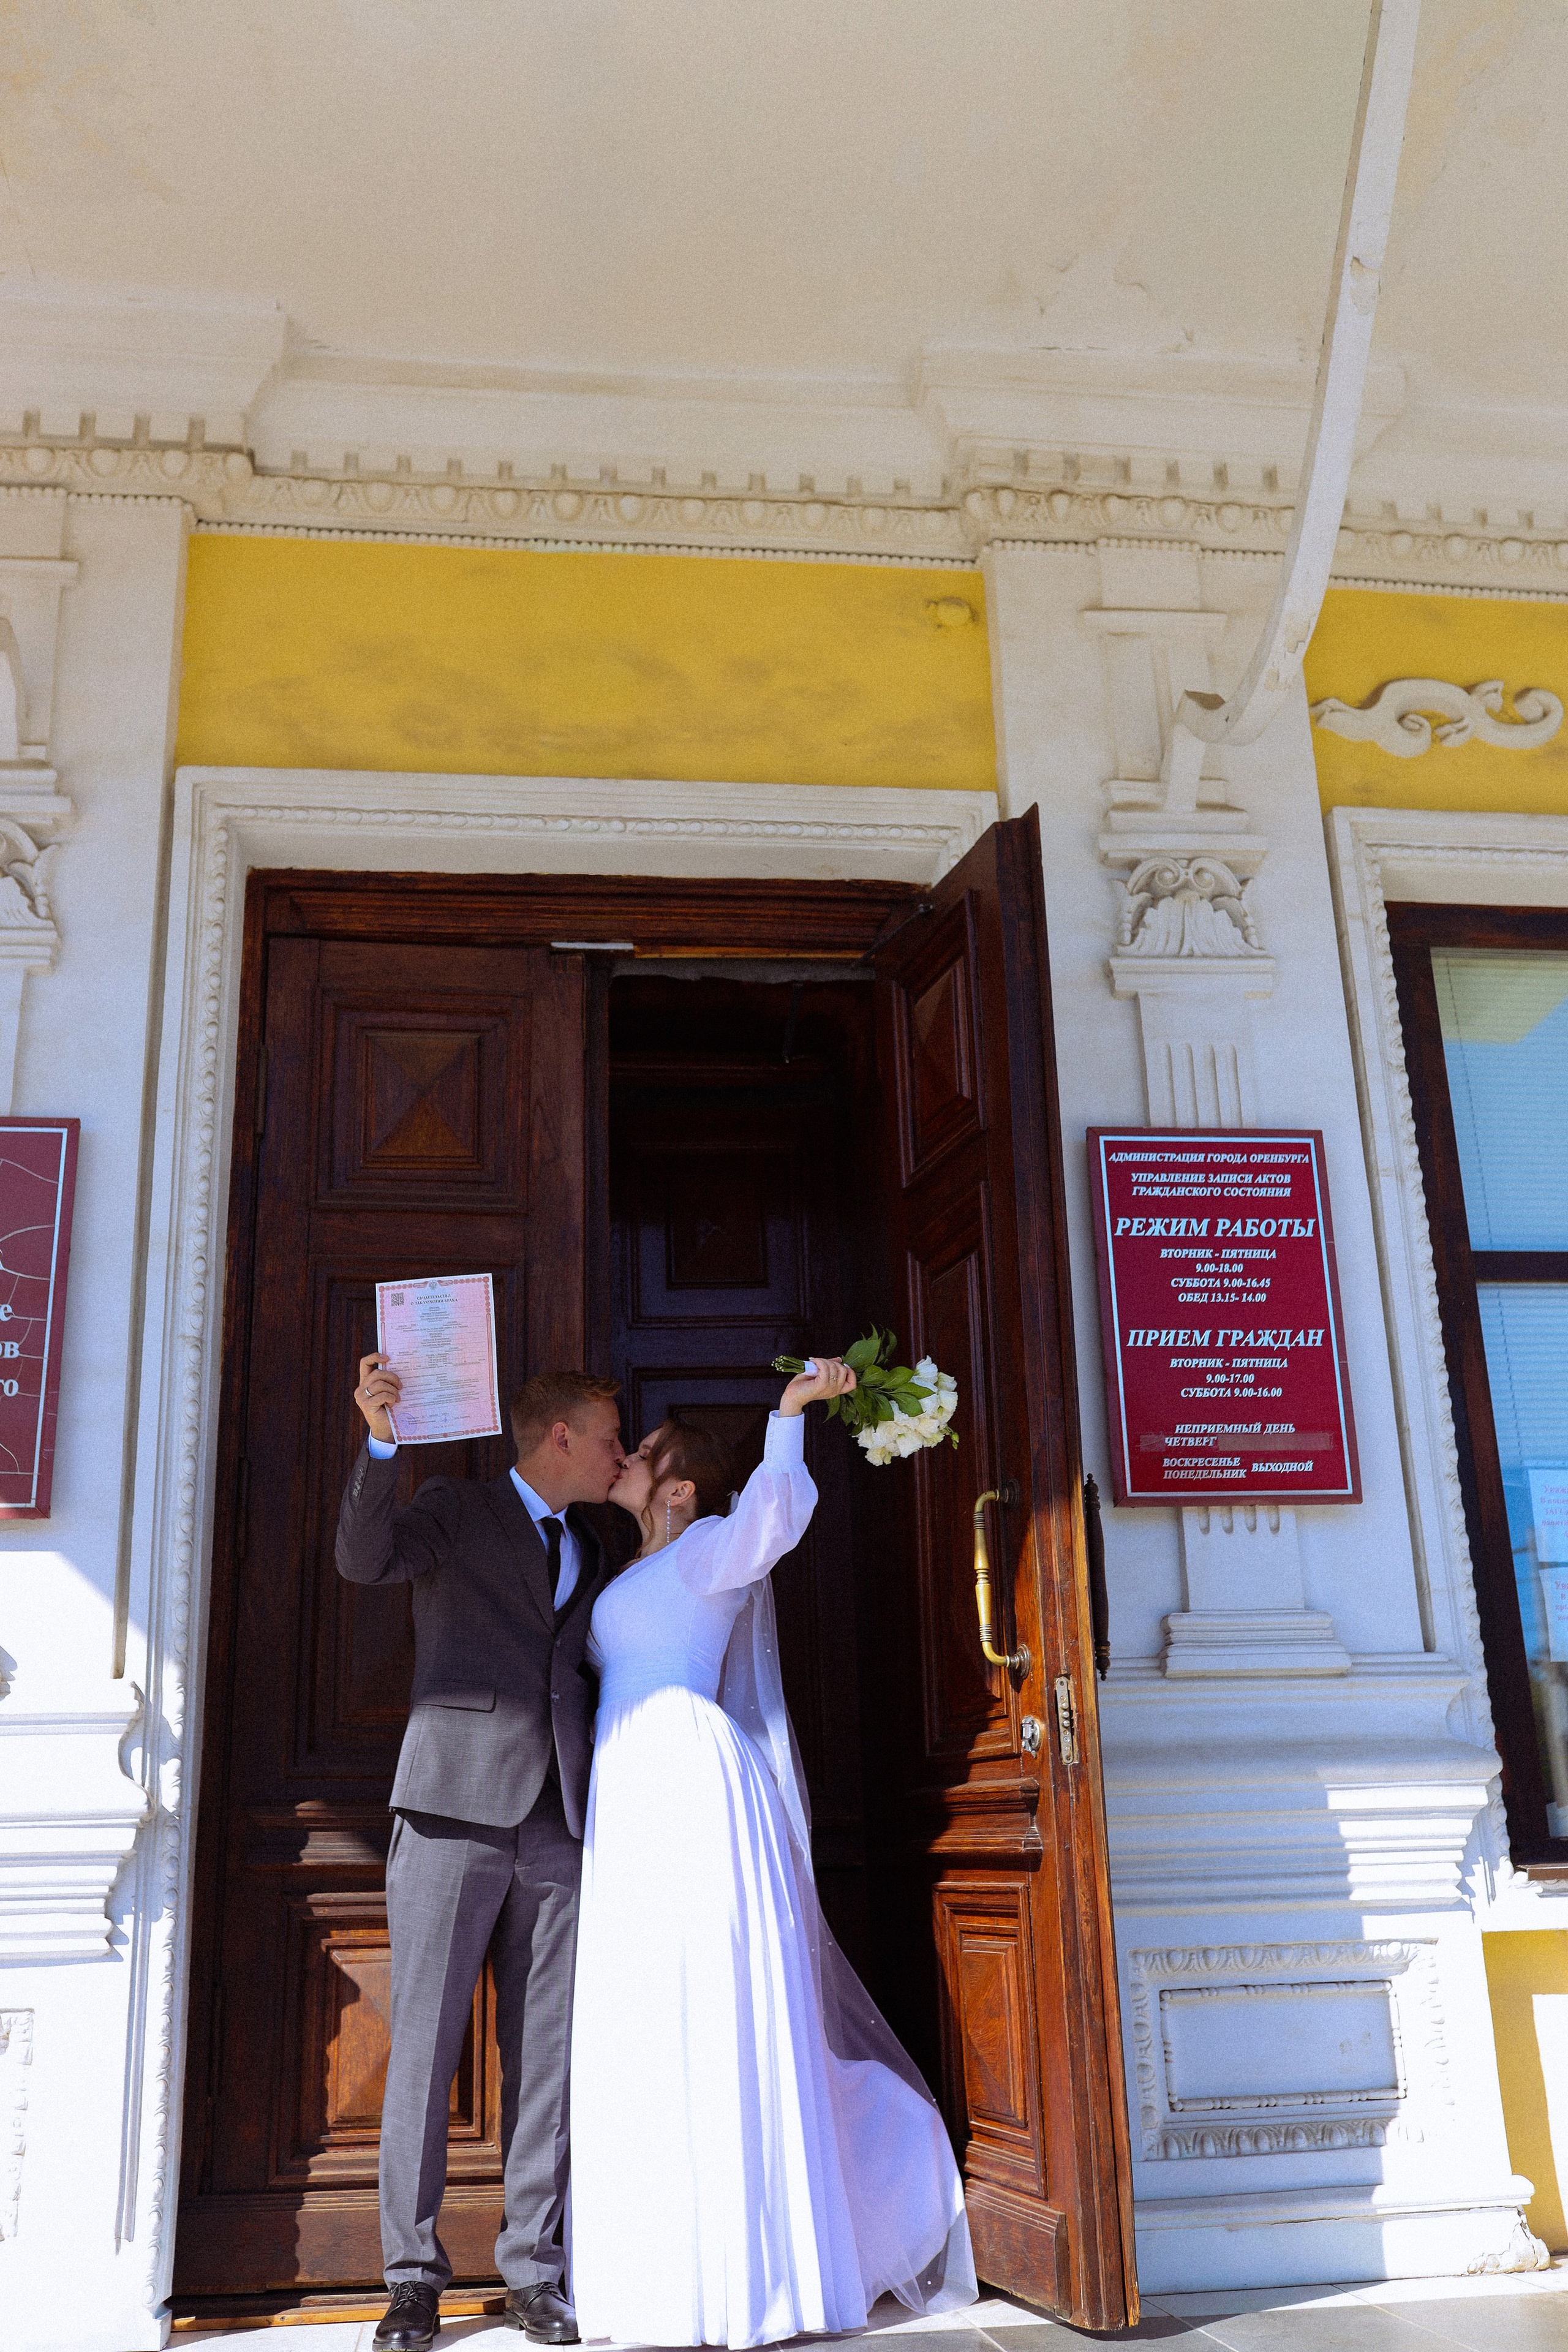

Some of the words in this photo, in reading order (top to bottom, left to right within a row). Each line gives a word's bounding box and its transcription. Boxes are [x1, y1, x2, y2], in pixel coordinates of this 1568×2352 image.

[1109, 1152, 1205, 1163] АДМИНИСТРАЦИЯ
[1207, 1153, 1247, 1164] ГОРОДА
[1250, 1153, 1309, 1164] ОРЕНБУРГА
[1131, 1173, 1205, 1183] УПРАВЛЕНИЕ
[1207, 1173, 1253, 1183] ЗАПИСИ
[1254, 1174, 1291, 1183] АКТОВ
[1132, 1186, 1221, 1197] ГРАЖДАНСКОГО
[1223, 1187, 1292, 1197] СОСТОЯНИЯ
[1114, 1217, 1210, 1237] РЕЖИМ
[1214, 1218, 1316, 1237] РАБОТЫ
[1160, 1248, 1213, 1259] ВТОРНИК
[1221, 1249, 1276, 1260] ПЯТНИЦА
[1196, 1263, 1243, 1273] 9.00-18.00
[1170, 1278, 1221, 1287] СУББОТА
[1223, 1278, 1271, 1287] 9.00-16.45
[1178, 1292, 1209, 1303] ОБЕД
[1242, 1292, 1267, 1303] 14.00
[1126, 1329, 1212, 1347] ПРИЕМ
[1215, 1329, 1325, 1351] ГРАЖДАН
[1169, 1358, 1224, 1368] ВТОРНИК
[1231, 1358, 1288, 1370] ПЯТНИЦА
[1205, 1373, 1255, 1384] 9.00-17.00
[1180, 1387, 1232, 1398] СУББОТА
[1234, 1387, 1283, 1398] 9.00-16.00
[1174, 1422, 1262, 1434] НЕПРИЕМНЫЙ
[1263, 1423, 1296, 1434] ДЕНЬ
[1164, 1436, 1217, 1447] ЧЕТВЕРГ
[1163, 1457, 1241, 1467] ВОСКРЕСЕНЬЕ
[1251, 1460, 1314, 1474] ВЫХОДНОЙ
[1163, 1469, 1247, 1480] ПОНЕДЕЛЬНИК
